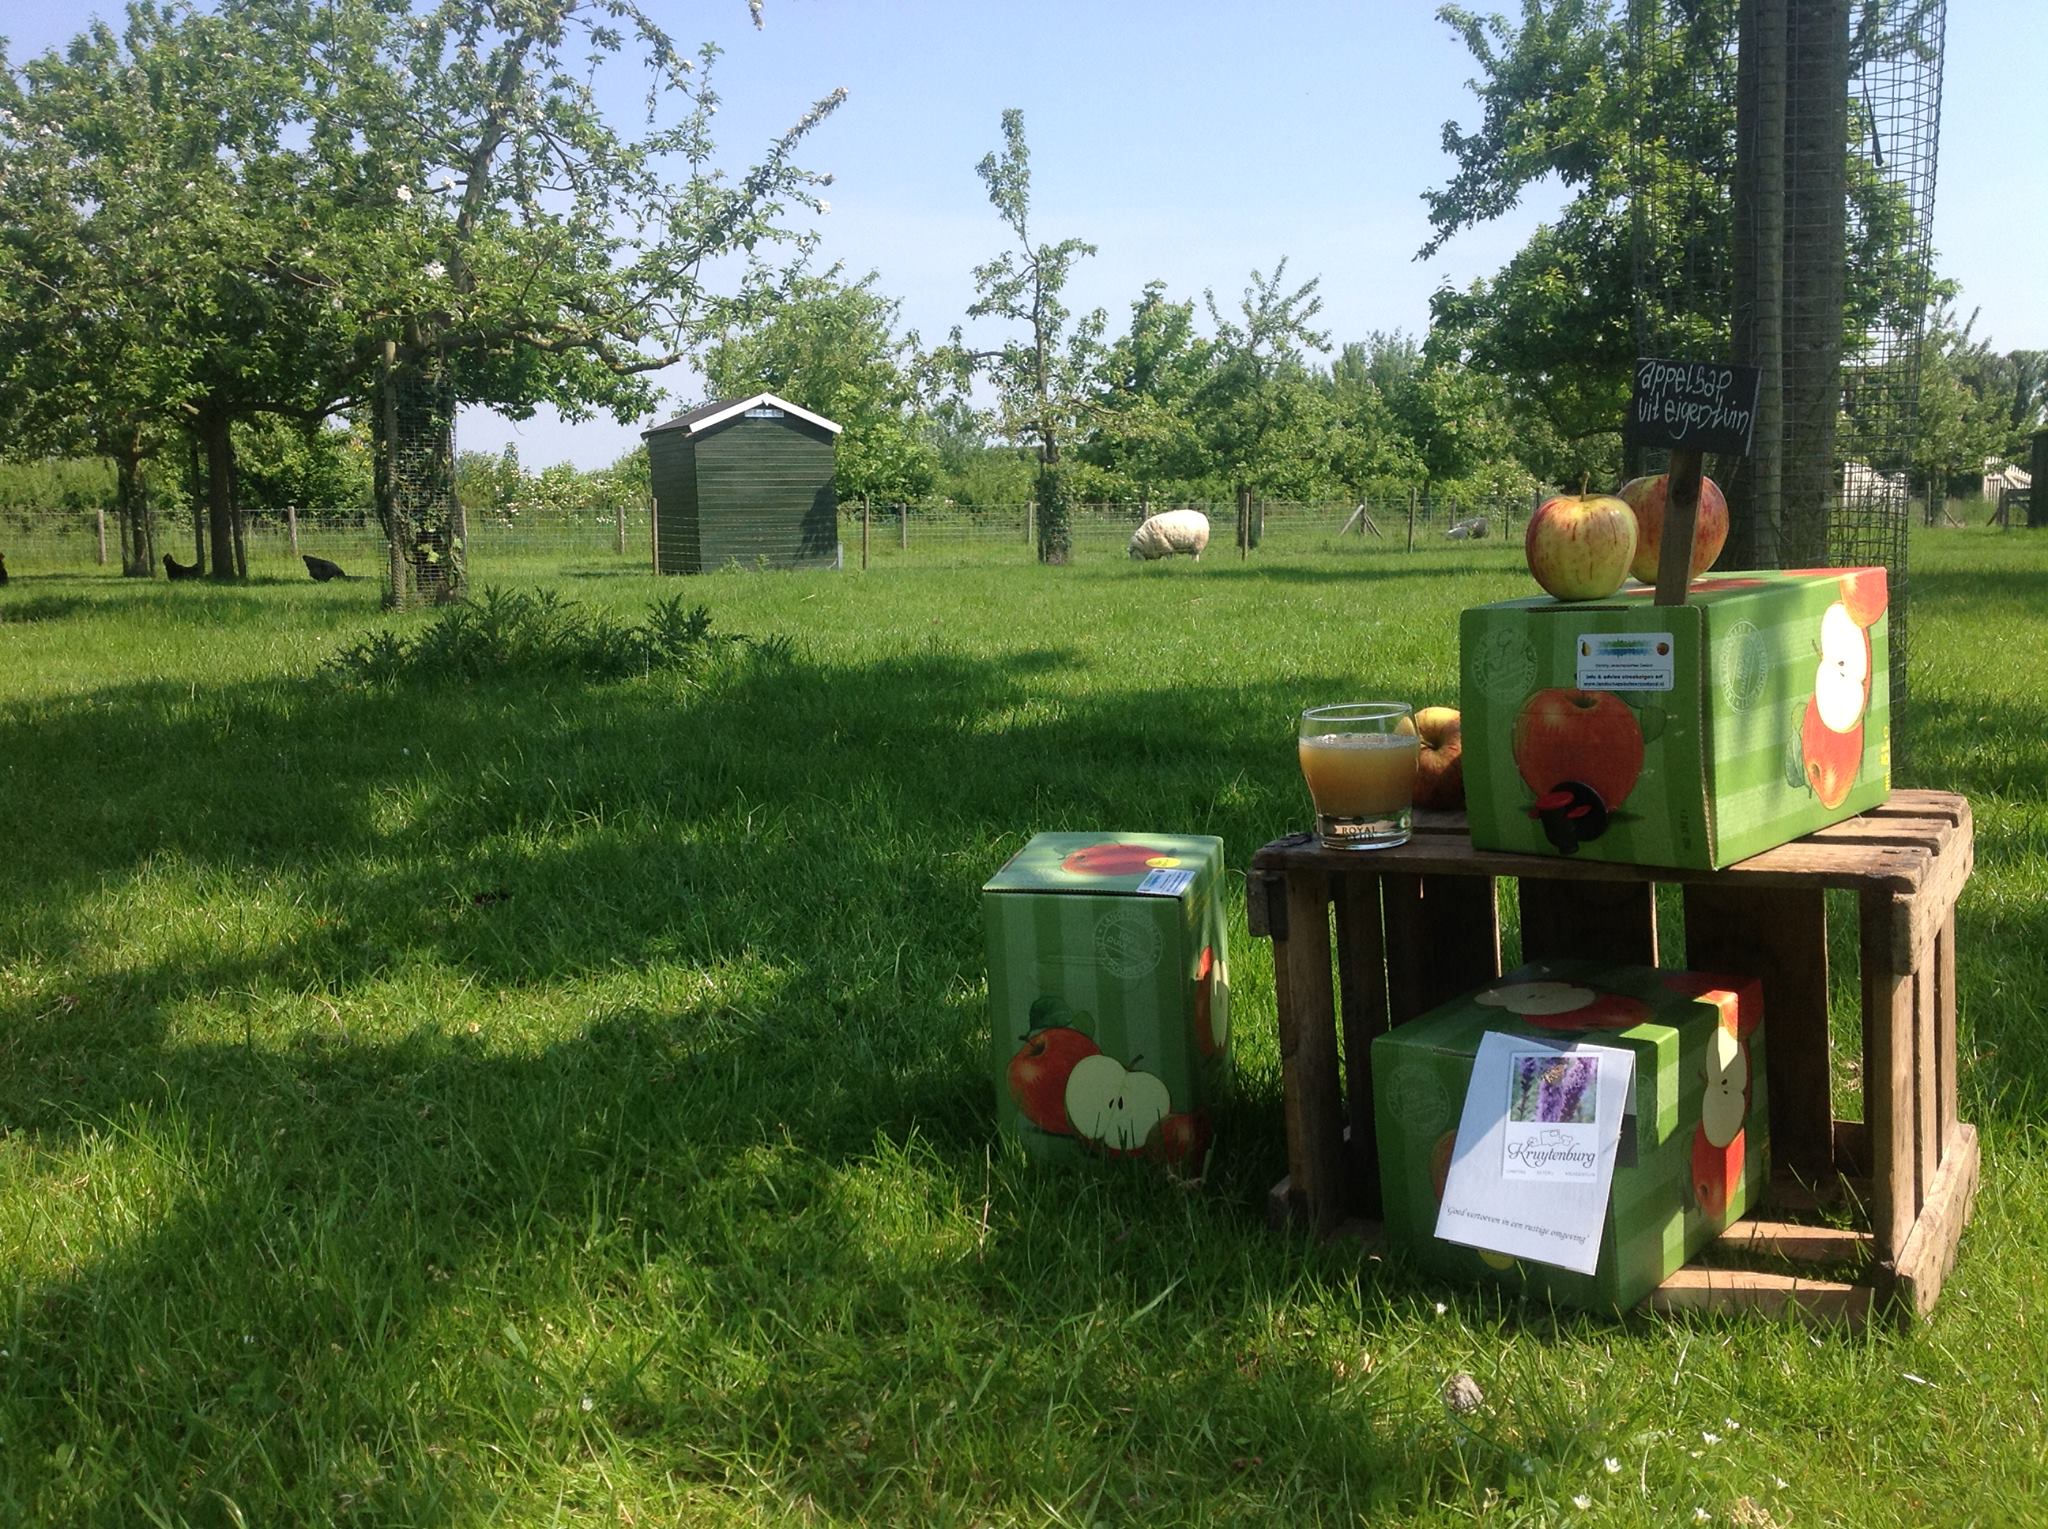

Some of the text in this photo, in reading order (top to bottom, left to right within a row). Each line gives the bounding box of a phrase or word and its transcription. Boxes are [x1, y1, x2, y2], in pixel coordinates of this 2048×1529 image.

[1664, 396, 1712, 440] eigen
[1711, 395, 1750, 436] tuin
[1342, 826, 1377, 835] ROYAL
[1507, 1142, 1596, 1168] Kruytenburg
[1501, 1219, 1510, 1227] in
[1510, 1220, 1523, 1229] een
[1524, 1224, 1550, 1237] rustige
